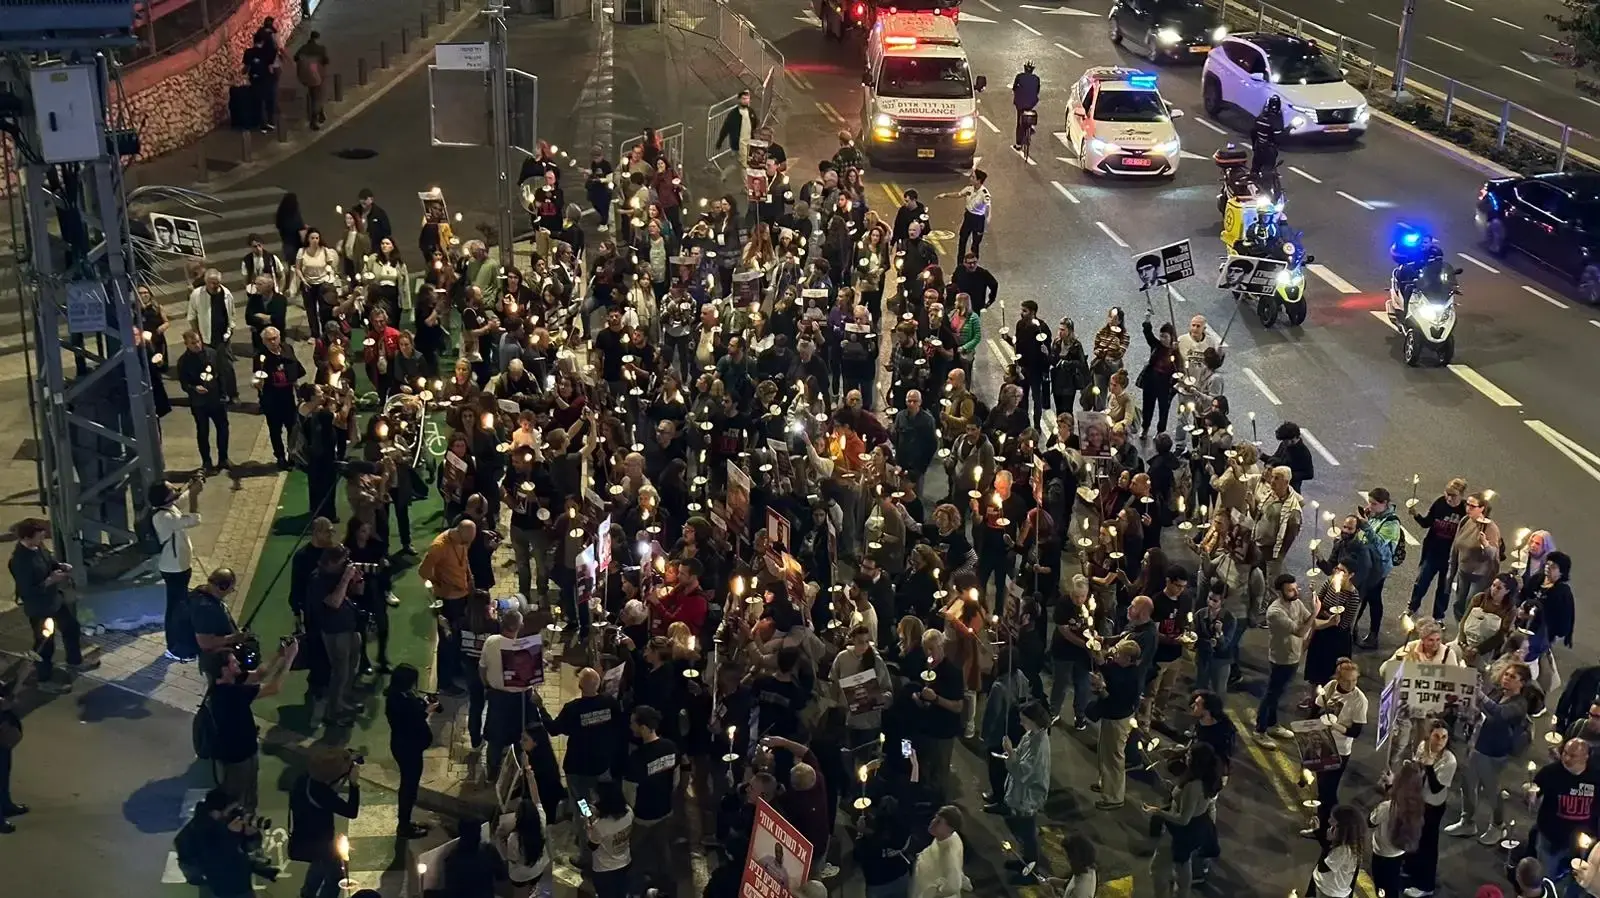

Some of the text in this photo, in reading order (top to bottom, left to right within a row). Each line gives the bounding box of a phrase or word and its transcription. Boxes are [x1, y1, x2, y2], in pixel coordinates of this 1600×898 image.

[760, 811, 807, 862] אל תשכחו אותי
